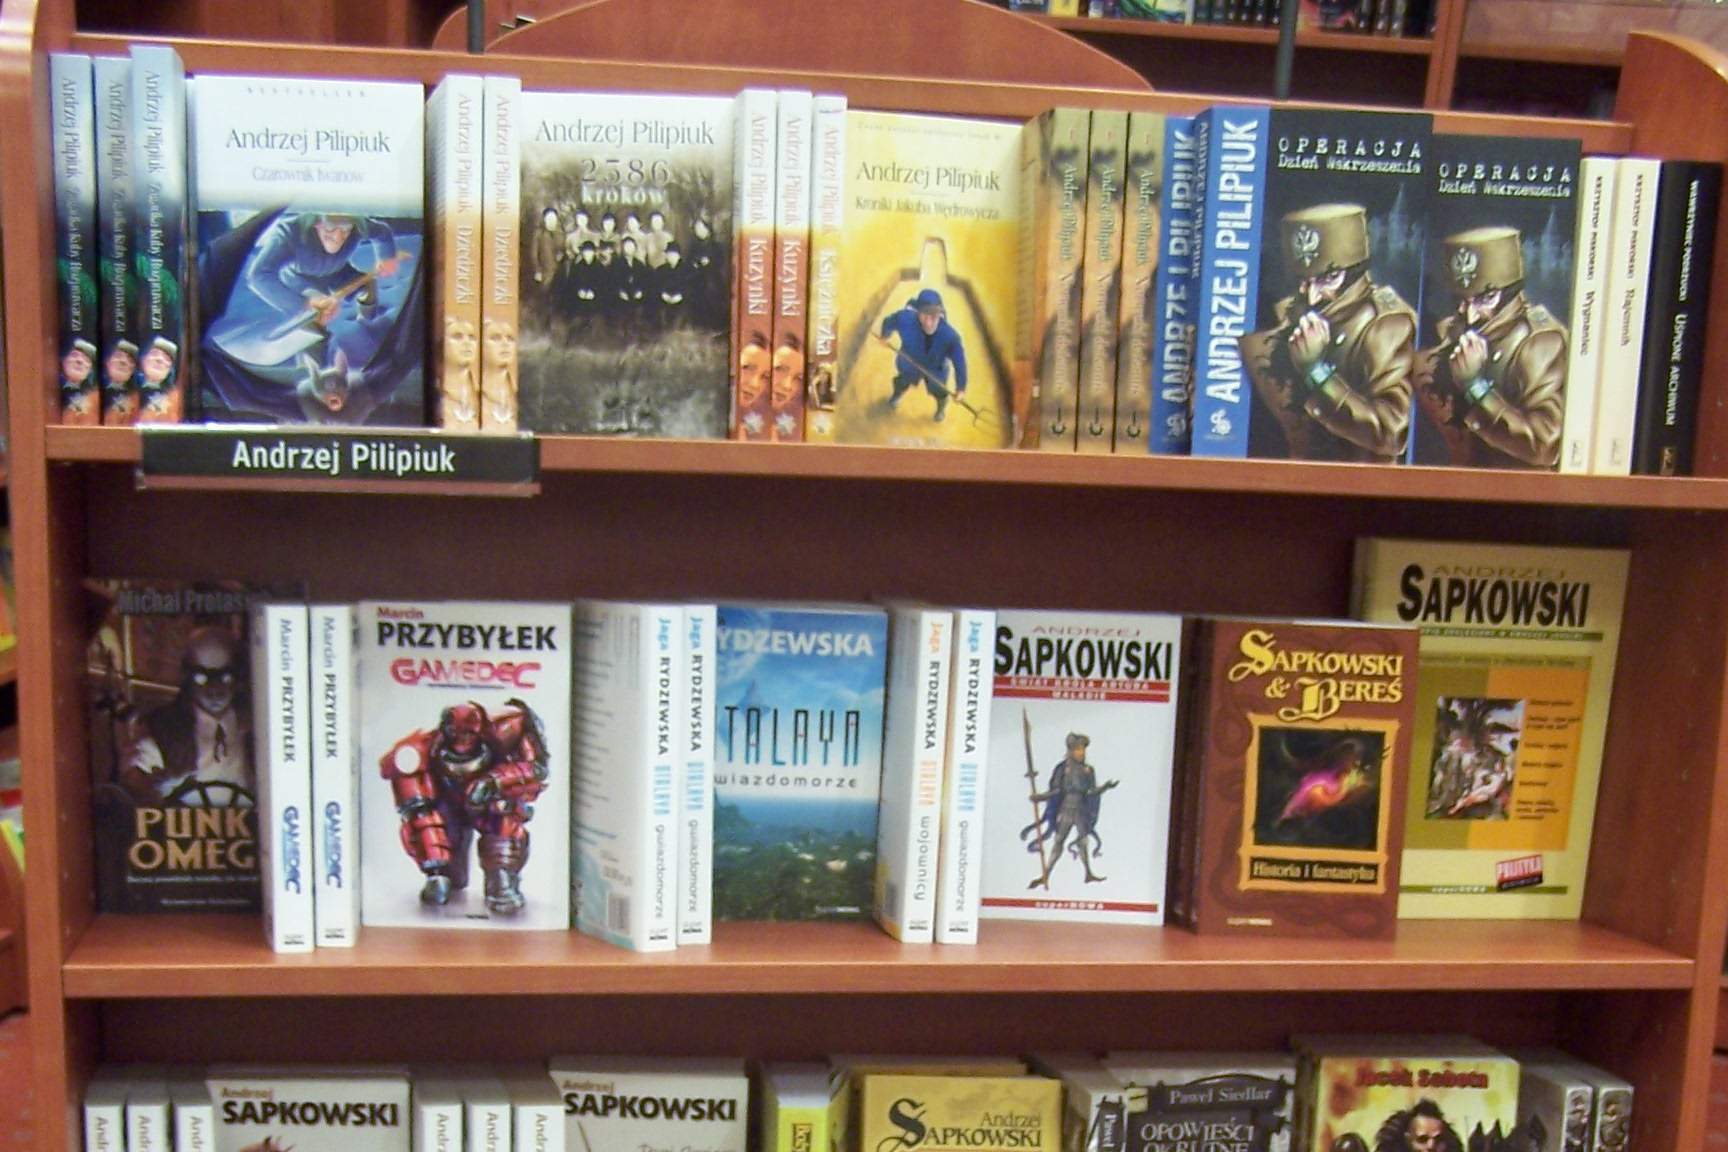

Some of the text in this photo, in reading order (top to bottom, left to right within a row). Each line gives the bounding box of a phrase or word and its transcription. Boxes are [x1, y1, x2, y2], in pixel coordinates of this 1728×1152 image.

[61, 78, 83, 179] Andrzej Pilipiuk
[108, 80, 128, 180] Andrzej Pilipiuk
[144, 70, 164, 175] Andrzej Pilipiuk
[535, 119, 714, 149] Andrzej Pilipiuk
[226, 127, 391, 157] Andrzej Pilipiuk
[821, 126, 840, 179] Andrzej
[1278, 136, 1422, 159] OPERACJA
[252, 165, 315, 183] Czarownik
[581, 157, 671, 186] 2586
[856, 160, 1001, 193] Andrzej Pilipiuk
[1277, 154, 1319, 171] Dzień
[1438, 162, 1573, 184] OPERACJA
[454, 94, 473, 306] Andrzej Pilipiuk Dziedziczki
[492, 95, 511, 306] Andrzej Pilipiuk Dziedziczki
[1438, 178, 1477, 194] Dzień
[748, 113, 768, 316] Andrzej Pilipiuk Kuzynki
[781, 114, 801, 317] Andrzej Pilipiuk Kuzynki
[820, 180, 839, 236] Pilipiuk
[855, 195, 1000, 221] Kroniki Jakuba Wędrowycza
[1206, 119, 1258, 405] ANDRZEJ PILIPIUK
[1664, 365, 1681, 426] ARCHIWUM
[233, 440, 456, 476] Andrzej Pilipiuk
[377, 606, 425, 620] Marcin
[1398, 563, 1591, 629] SAPKOWSKI
[377, 622, 557, 651] PRZYBYŁEK
[967, 620, 983, 654] Jaga
[1032, 624, 1141, 637] ANDRZEJ
[994, 626, 1173, 680] SAPKOWSKI
[1228, 629, 1404, 682] SAPKOWSKI
[280, 618, 297, 763] Marcin PRZYBYŁEK
[322, 616, 338, 760] Marcin PRZYBYŁEK
[390, 658, 542, 689] GAMEDEC
[924, 660, 941, 751] RYDZEWSKA
[964, 658, 981, 754] RYDZEWSKA
[1265, 677, 1403, 722] & BEREŚ
[654, 617, 672, 920] Jaga RYDZEWSKA gwiazdomorze
[688, 617, 704, 915] Jaga RYDZEWSKA gwiazdomorze
[136, 807, 251, 839] PUNK
[914, 815, 930, 901] wojownicy
[1254, 860, 1301, 880] Historia
[222, 1100, 399, 1127] SAPKOWSKI
[564, 1093, 737, 1121] SAPKOWSKI
[1169, 1086, 1272, 1105] Paweł Siedlar
[980, 1111, 1042, 1127] Andrzej
[1140, 1116, 1255, 1142] OPOWIEŚCI
